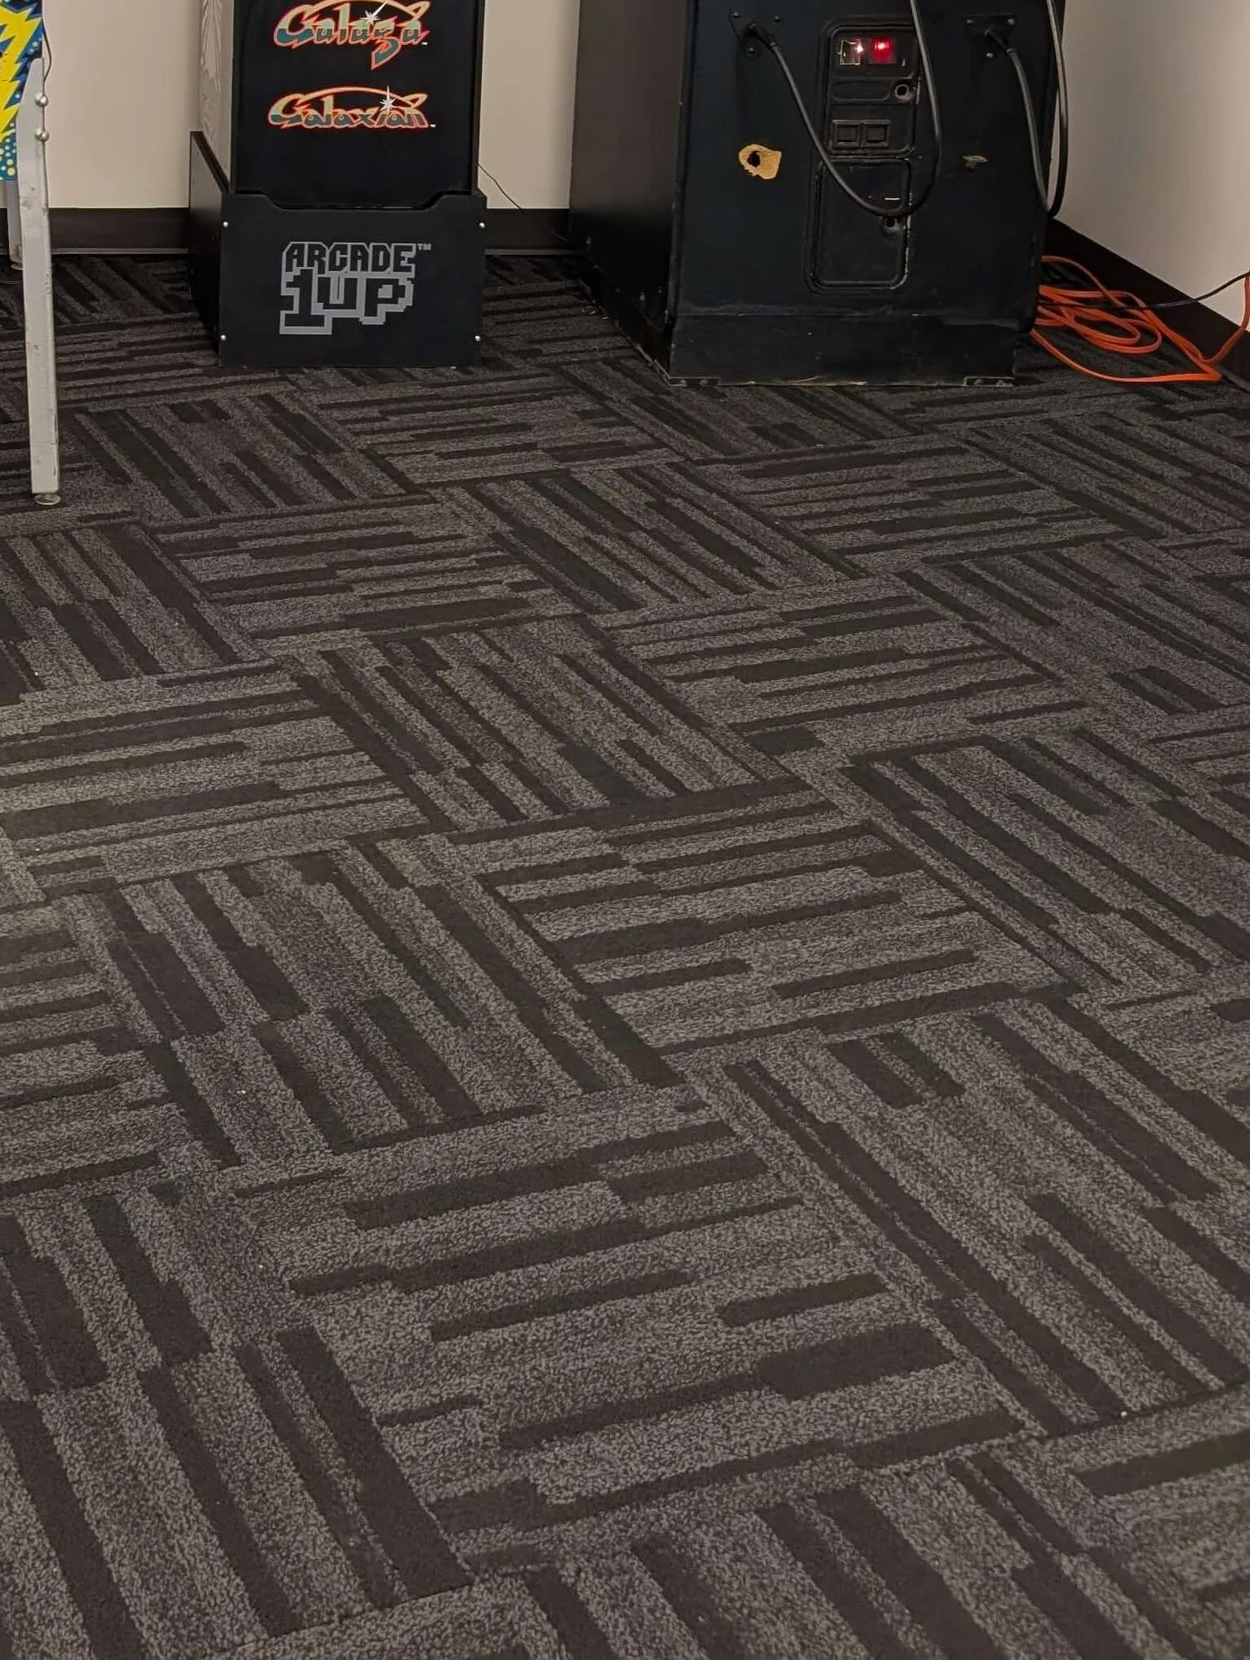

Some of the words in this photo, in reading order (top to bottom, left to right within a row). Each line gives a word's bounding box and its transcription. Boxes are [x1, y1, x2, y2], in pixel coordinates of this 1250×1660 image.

[267, 85, 431, 129] Galaxian
[281, 241, 416, 273] ARCADE
[279, 267, 415, 335] 1UP
